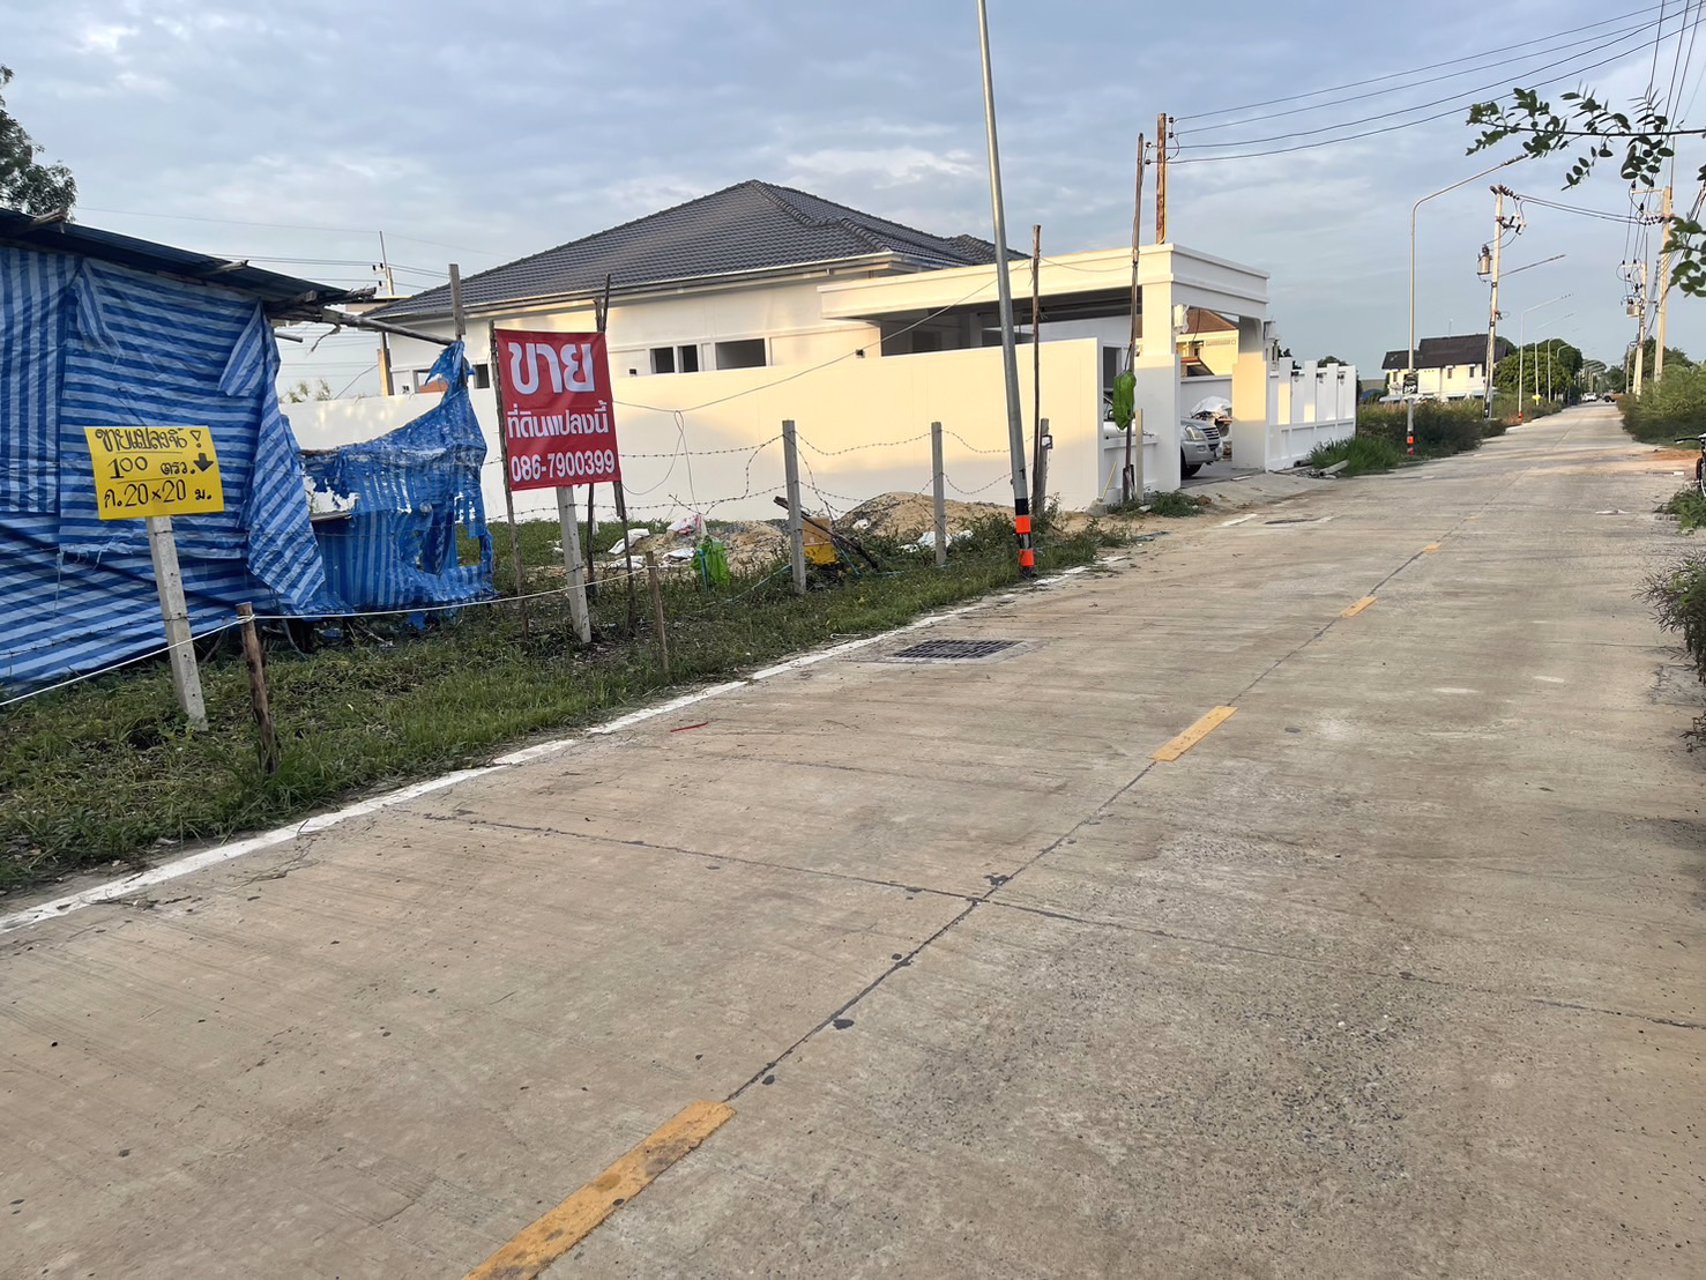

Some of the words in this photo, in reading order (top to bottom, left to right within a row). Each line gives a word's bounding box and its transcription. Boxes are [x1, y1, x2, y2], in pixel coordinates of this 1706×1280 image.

[508, 342, 595, 395] ขาย
[507, 400, 609, 438] ที่ดินแปลงนี้
[108, 456, 148, 479] 100
[511, 449, 615, 482] 086-7900399
